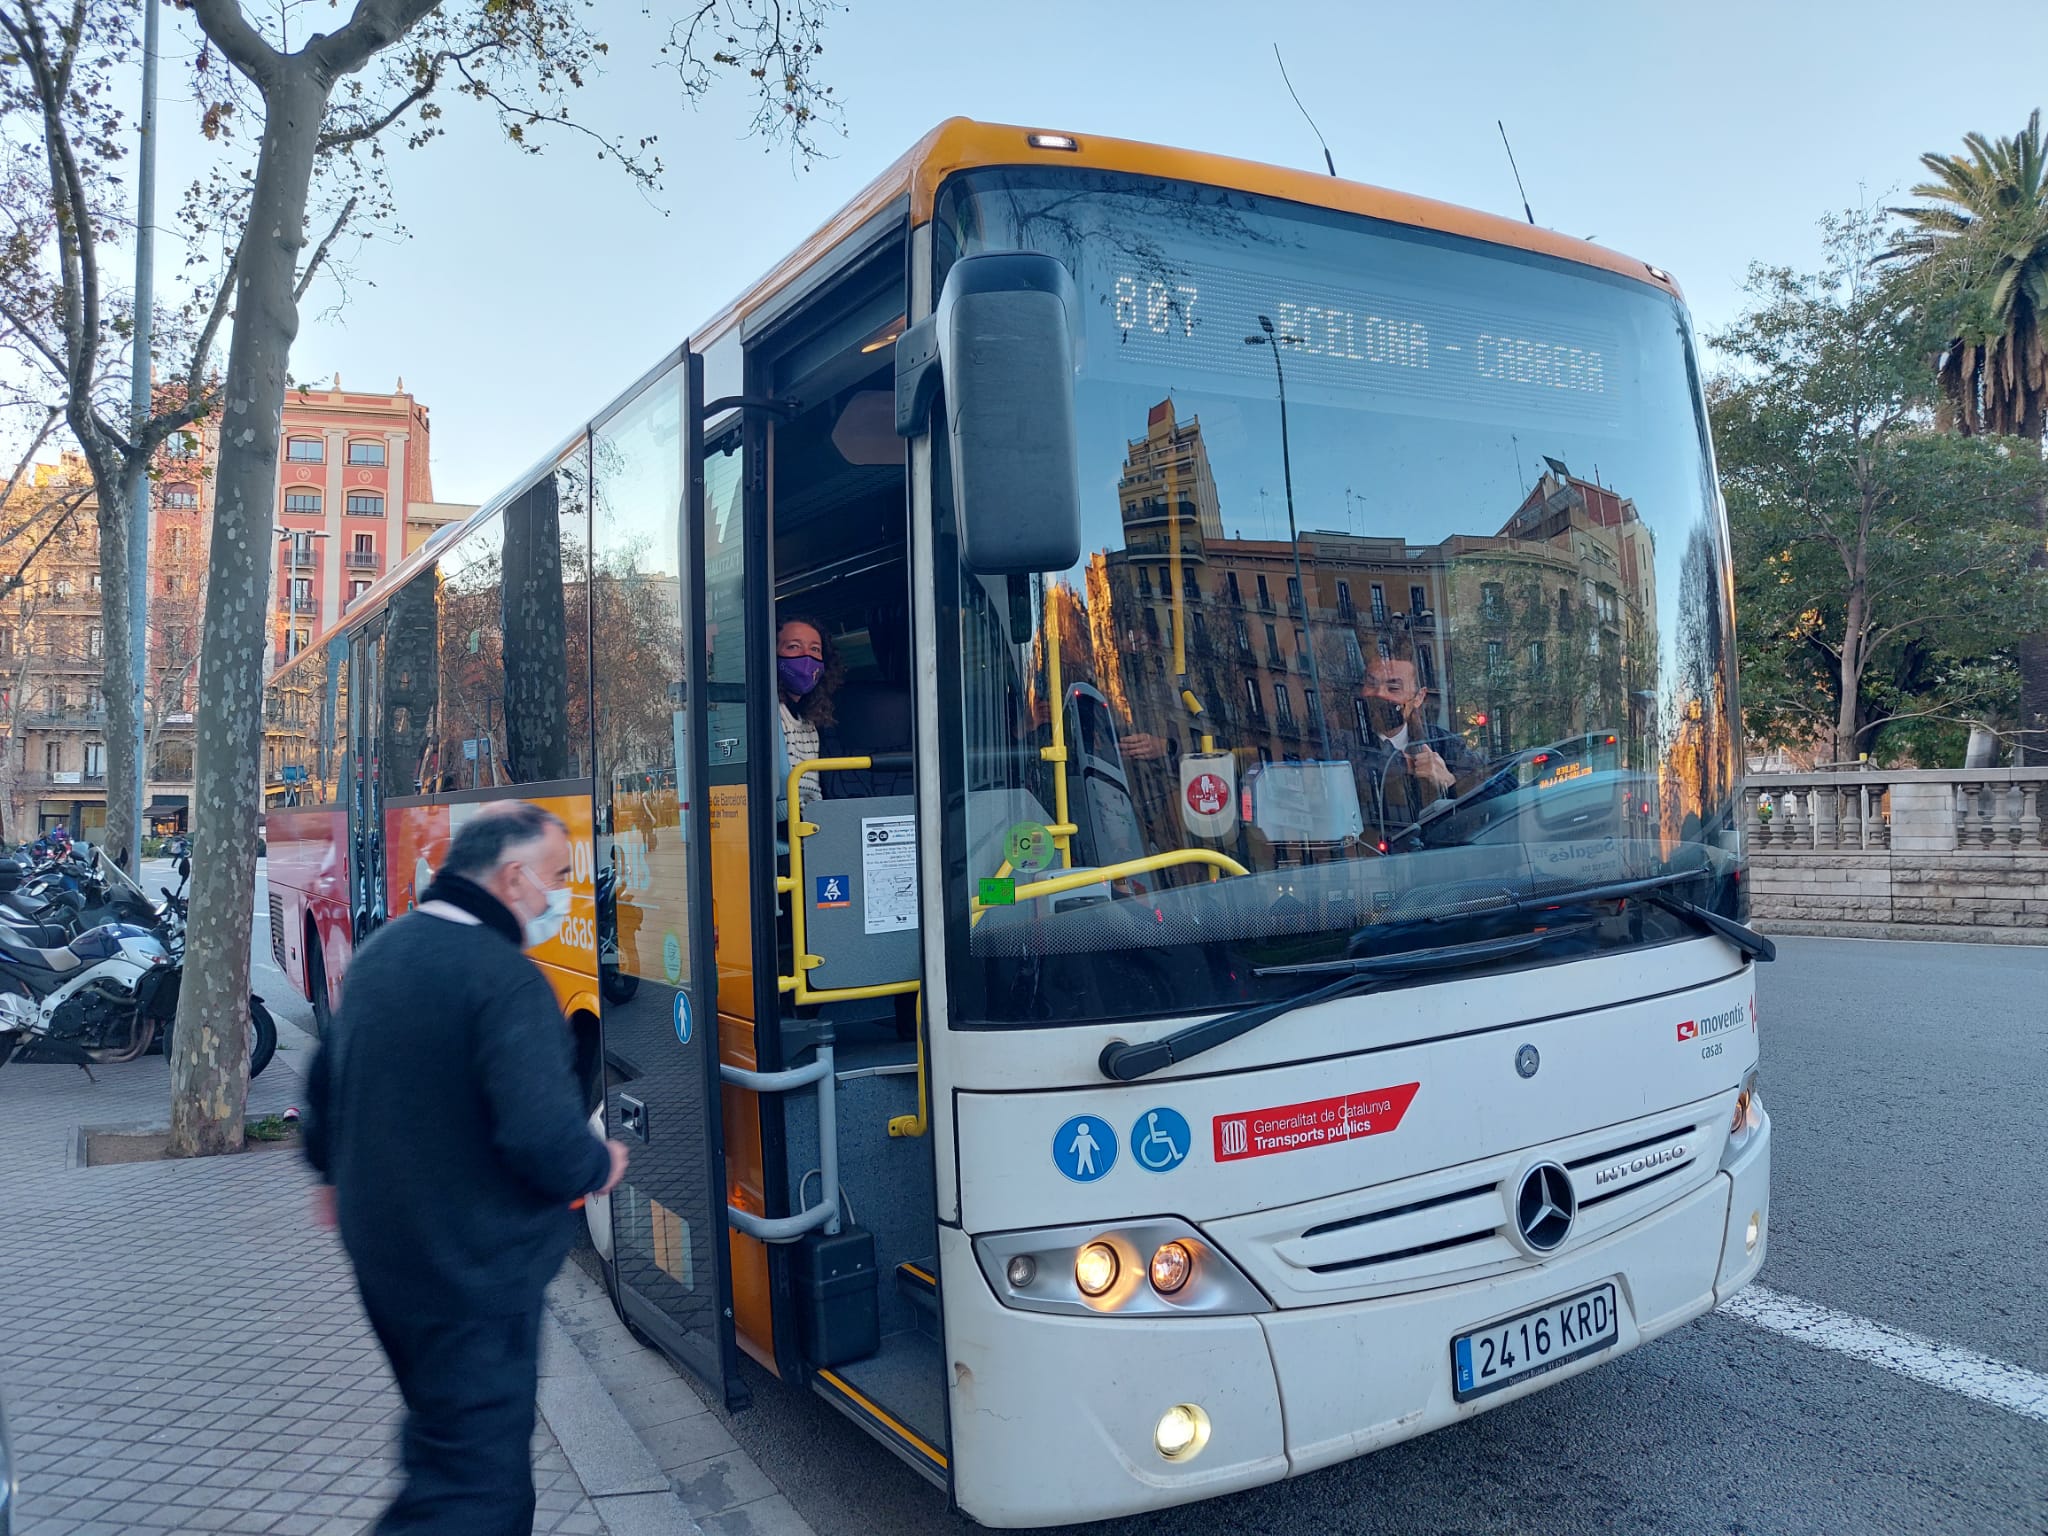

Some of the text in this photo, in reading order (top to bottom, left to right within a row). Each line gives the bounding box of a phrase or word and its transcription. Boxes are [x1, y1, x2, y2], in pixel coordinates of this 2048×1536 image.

[1115, 277, 1197, 337] 807
[1477, 333, 1605, 393] CABRERA
[1020, 838, 1031, 850] C
[560, 915, 595, 951] casas
[1700, 1001, 1744, 1036] moventis
[1701, 1042, 1723, 1060] casas
[1253, 1099, 1392, 1134] Generalitat de Catalunya
[1254, 1119, 1372, 1150] Transports públics
[1595, 1144, 1688, 1185] INTOURO
[1480, 1317, 1551, 1379] 2416
[1560, 1294, 1608, 1347] KRD
